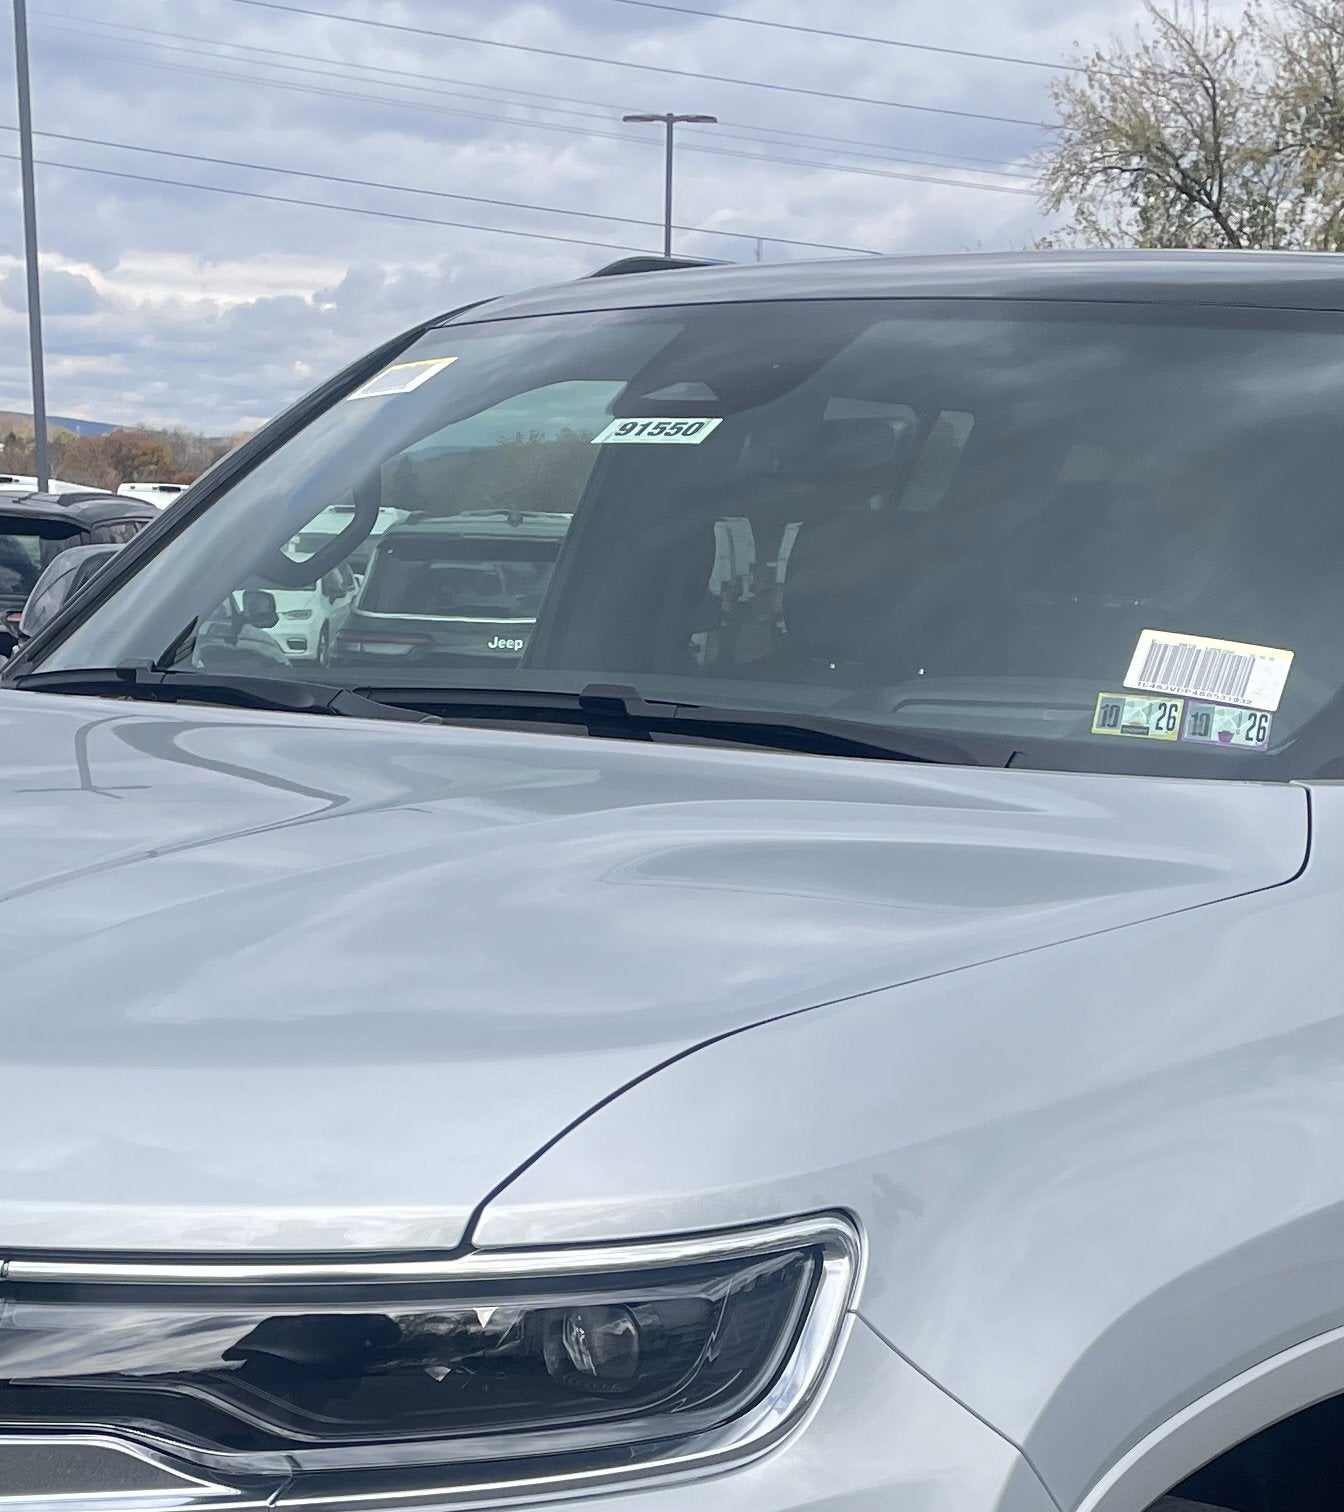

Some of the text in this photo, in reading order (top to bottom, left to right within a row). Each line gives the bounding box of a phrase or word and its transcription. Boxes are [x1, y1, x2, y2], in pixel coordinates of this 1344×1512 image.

[614, 421, 706, 437] 91550
[487, 635, 524, 652] Jeep
[1100, 704, 1121, 728] 10
[1155, 702, 1178, 732] 26
[1190, 711, 1269, 743] 10 26
